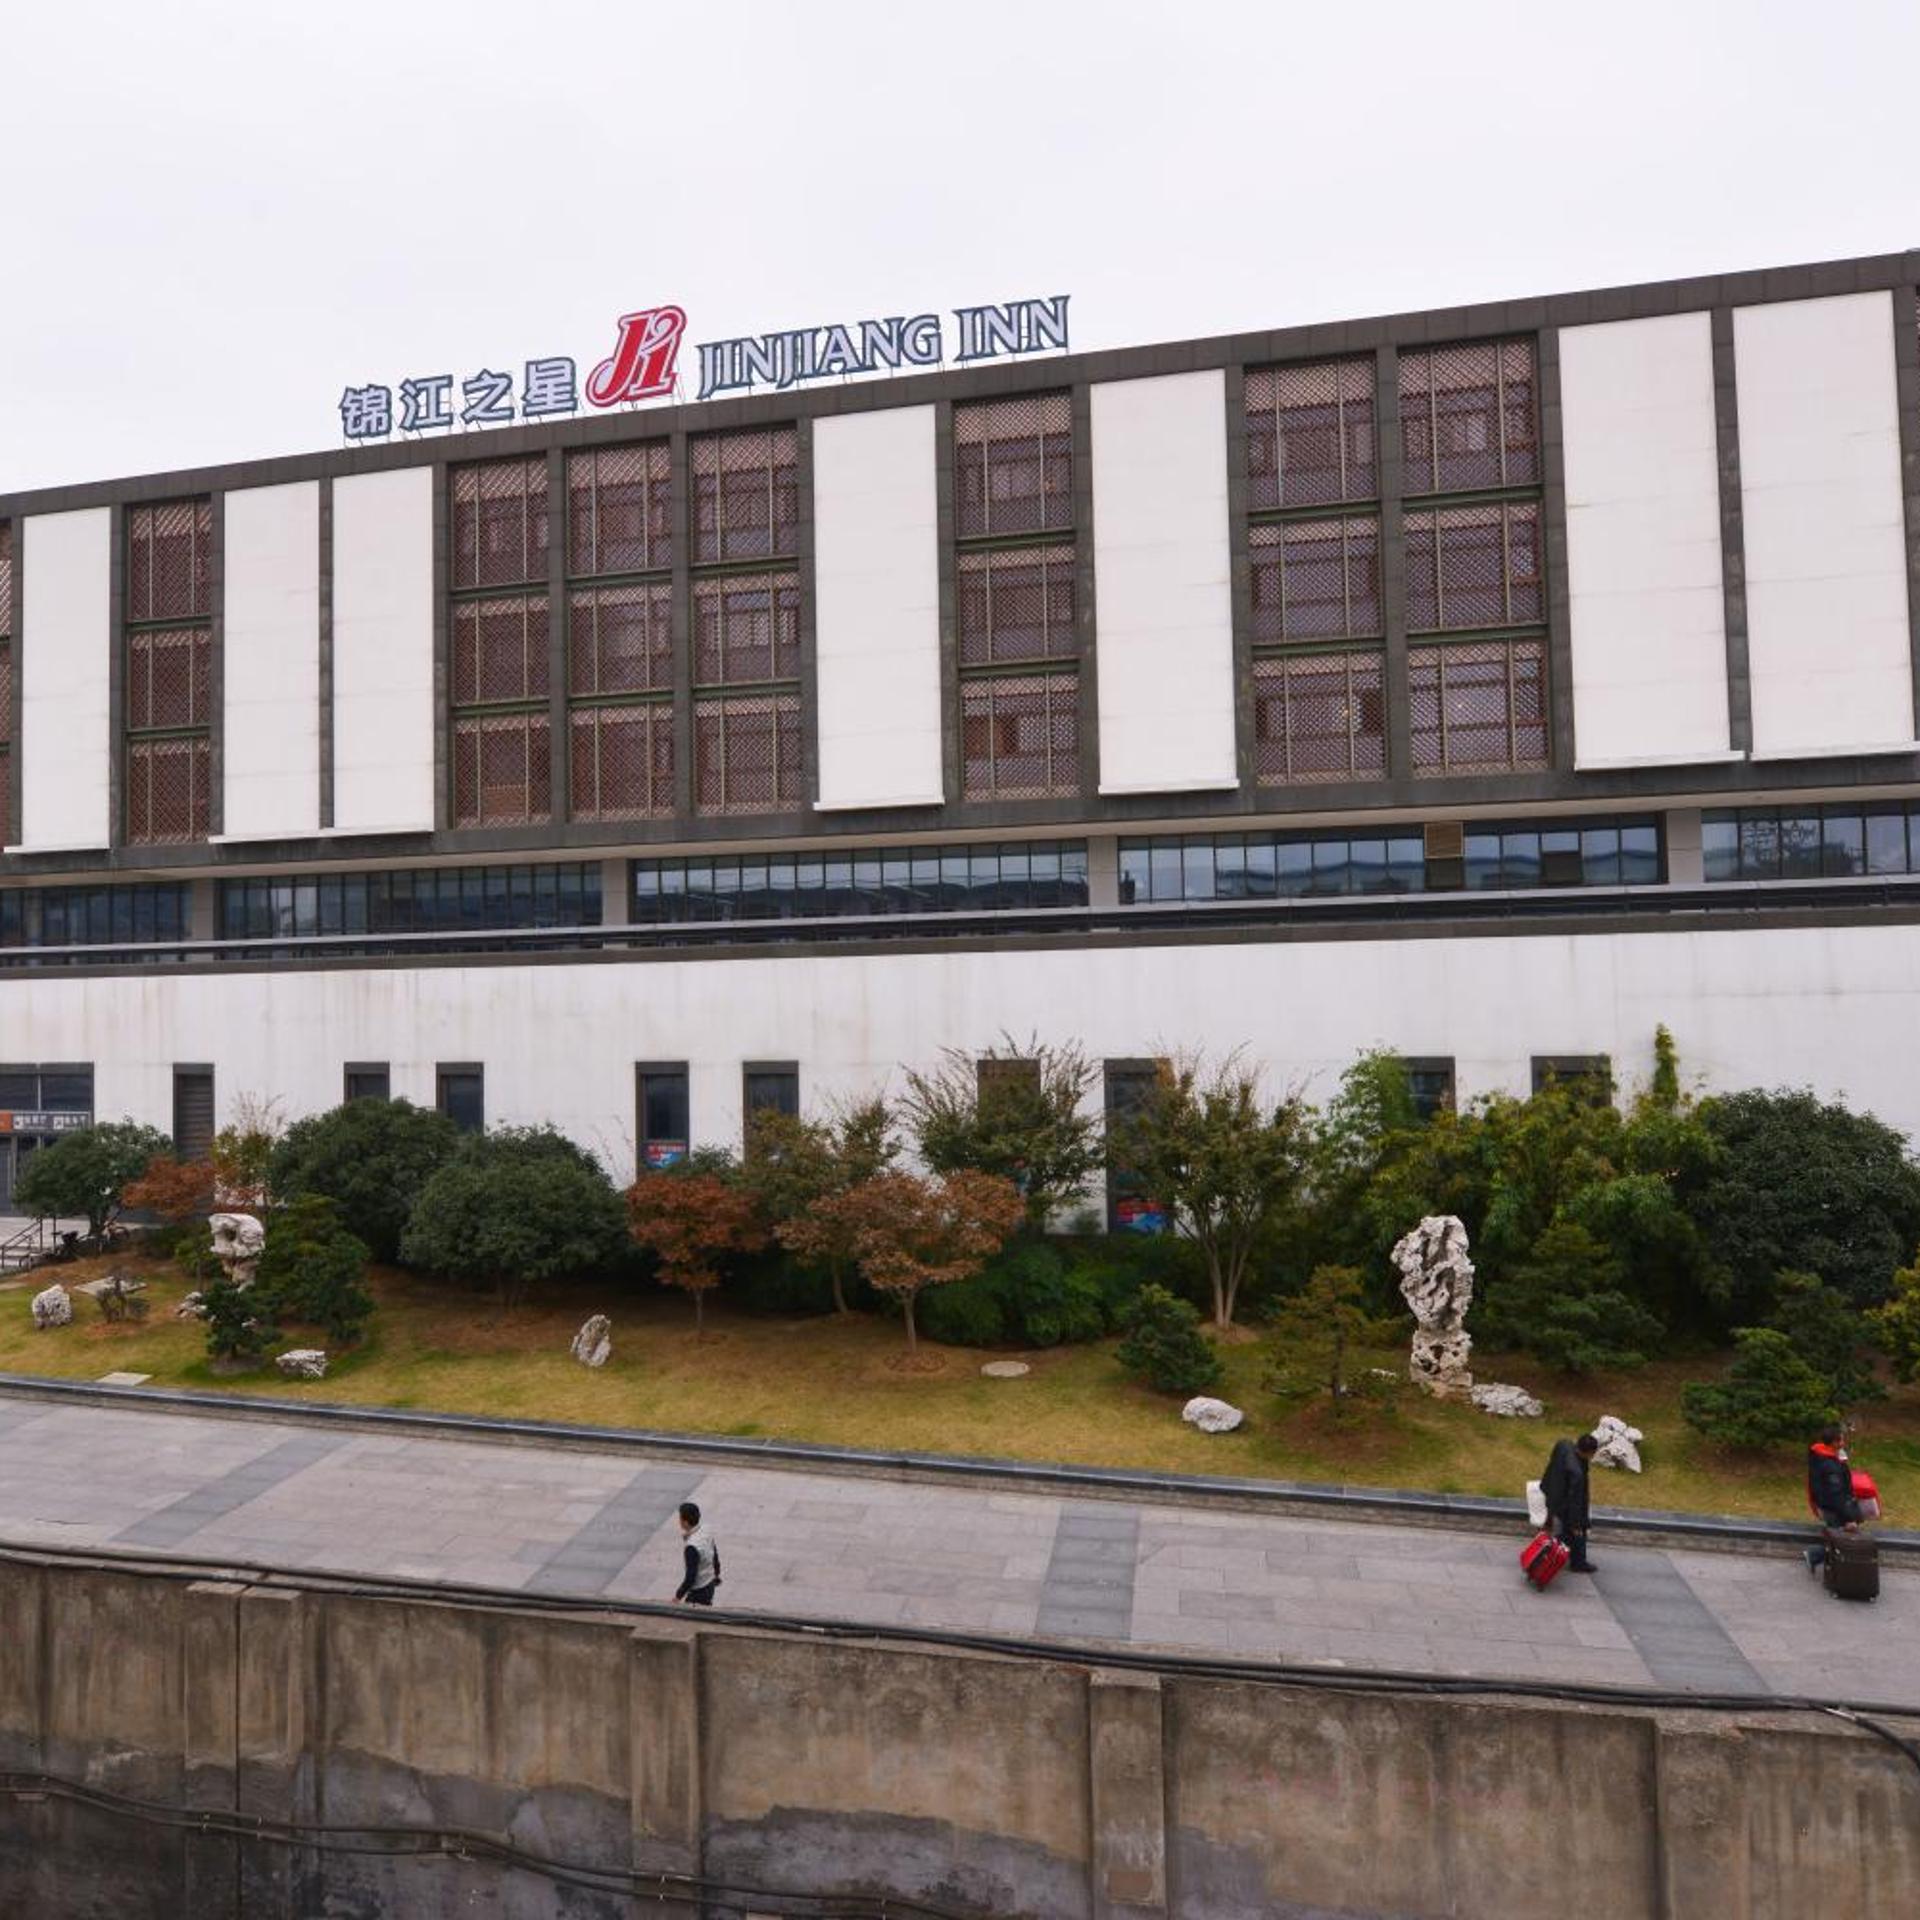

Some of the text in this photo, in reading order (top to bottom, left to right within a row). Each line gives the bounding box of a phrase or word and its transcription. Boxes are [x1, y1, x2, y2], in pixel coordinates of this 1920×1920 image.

[694, 295, 1070, 399] JINJIANG INN
[338, 357, 578, 438] 锦江之星
